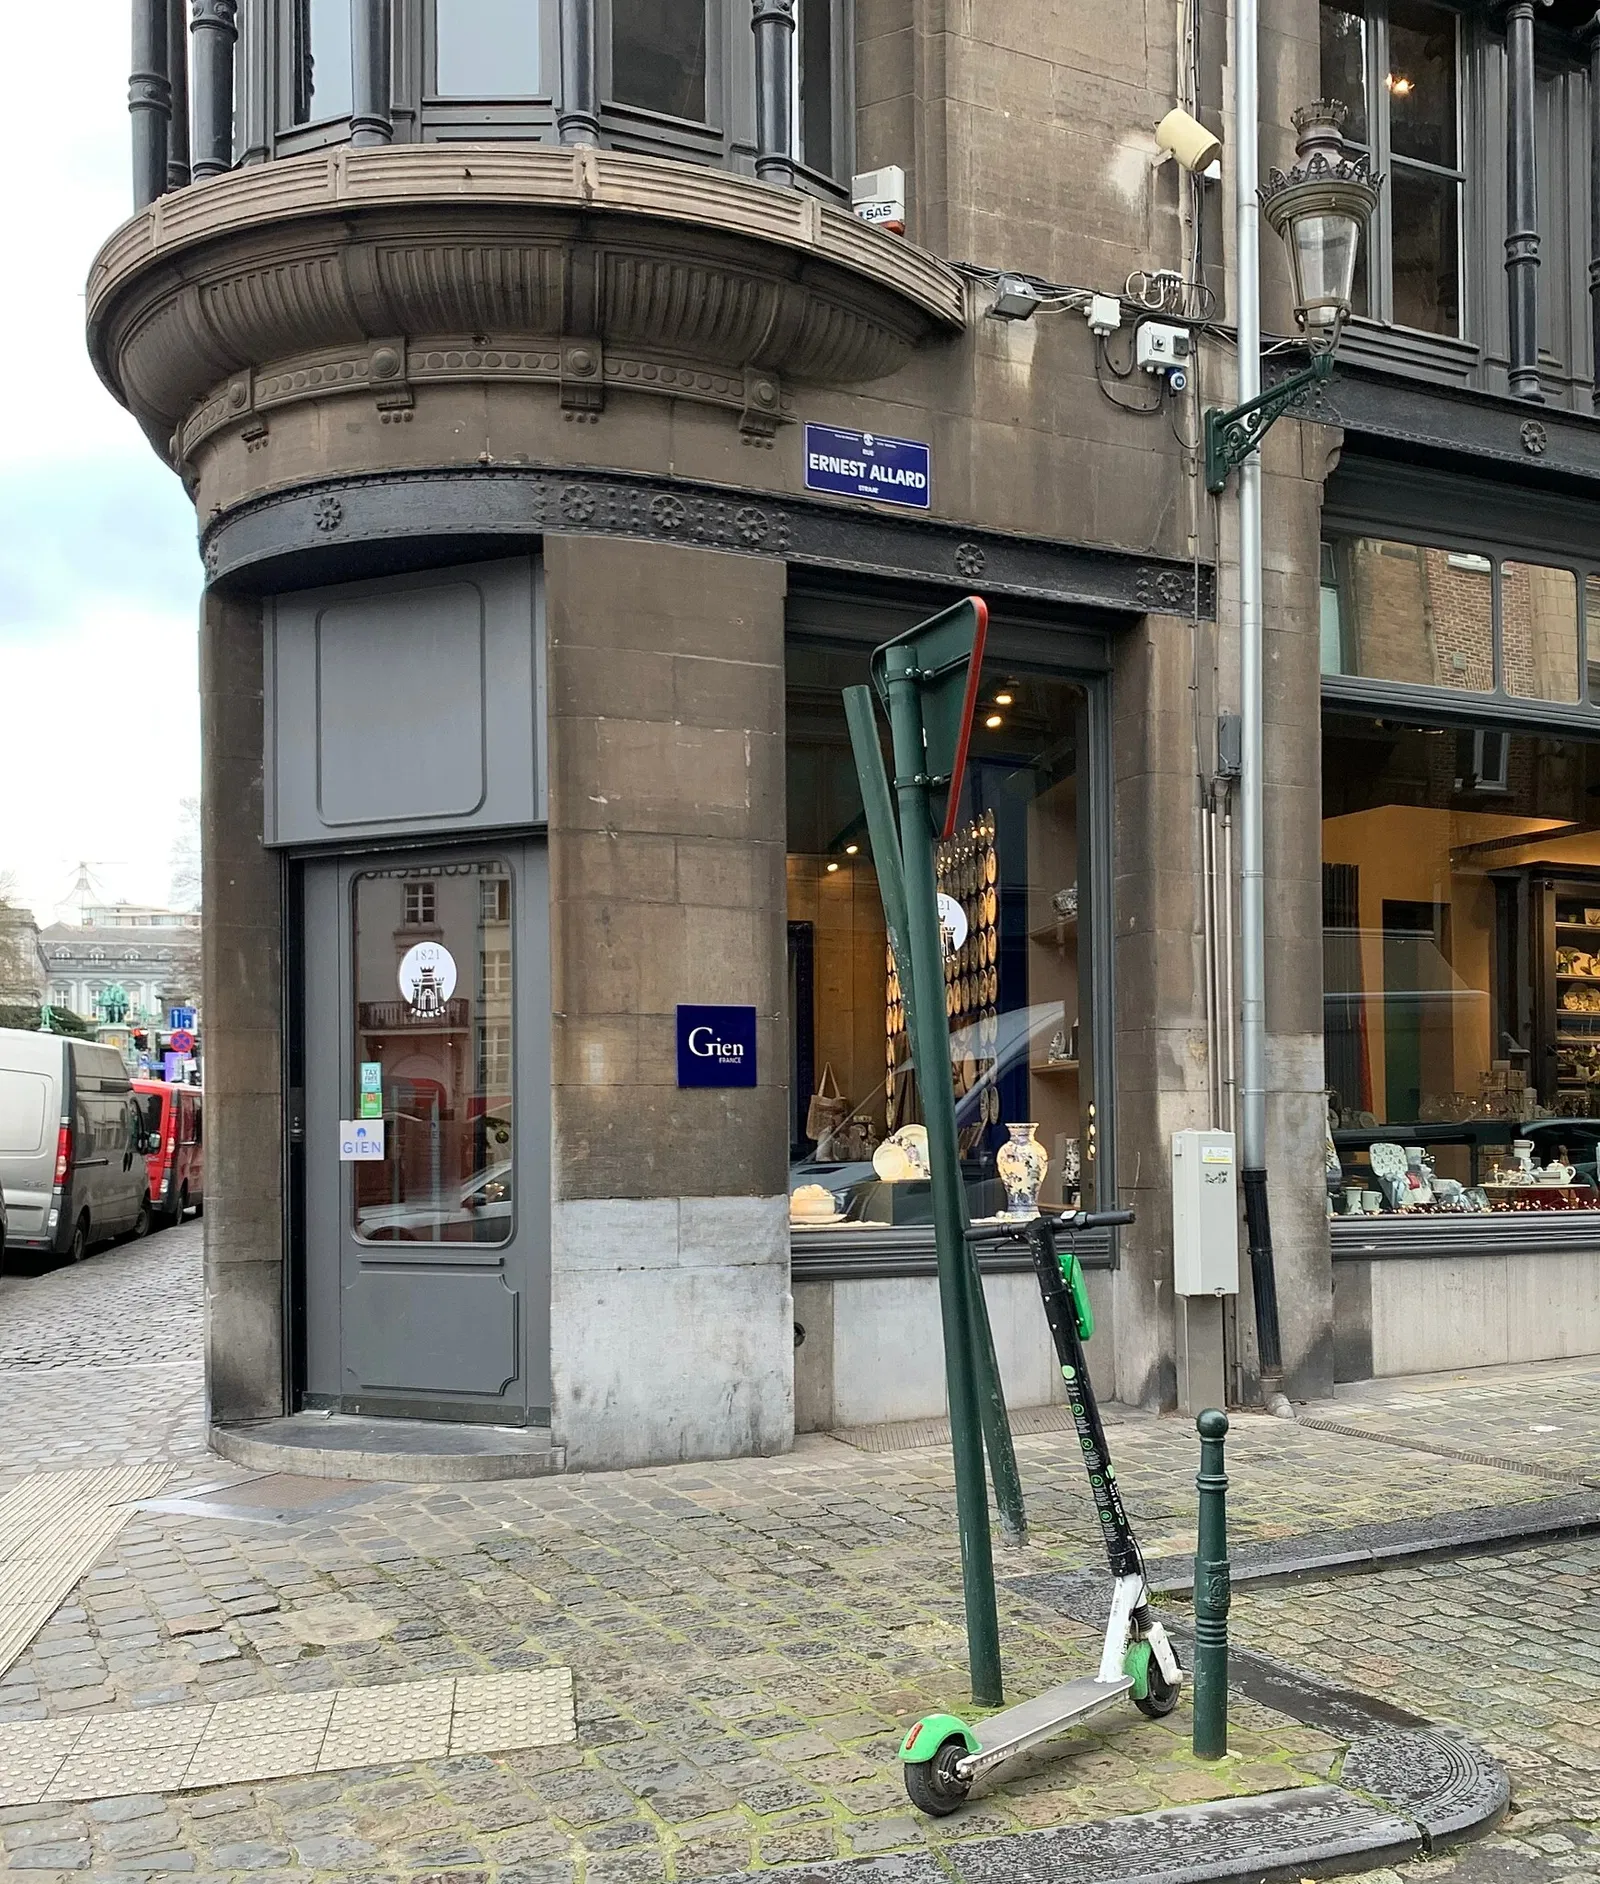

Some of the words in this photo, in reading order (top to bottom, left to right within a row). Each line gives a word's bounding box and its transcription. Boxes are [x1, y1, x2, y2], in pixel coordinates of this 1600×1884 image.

[866, 205, 892, 220] SAS
[862, 448, 875, 457] RUE
[809, 453, 867, 478] ERNEST
[869, 464, 926, 489] ALLARD
[415, 948, 440, 961] 1821
[410, 1005, 446, 1018] FRANCE
[688, 1026, 744, 1057] Gien
[343, 1141, 381, 1154] GIEN
